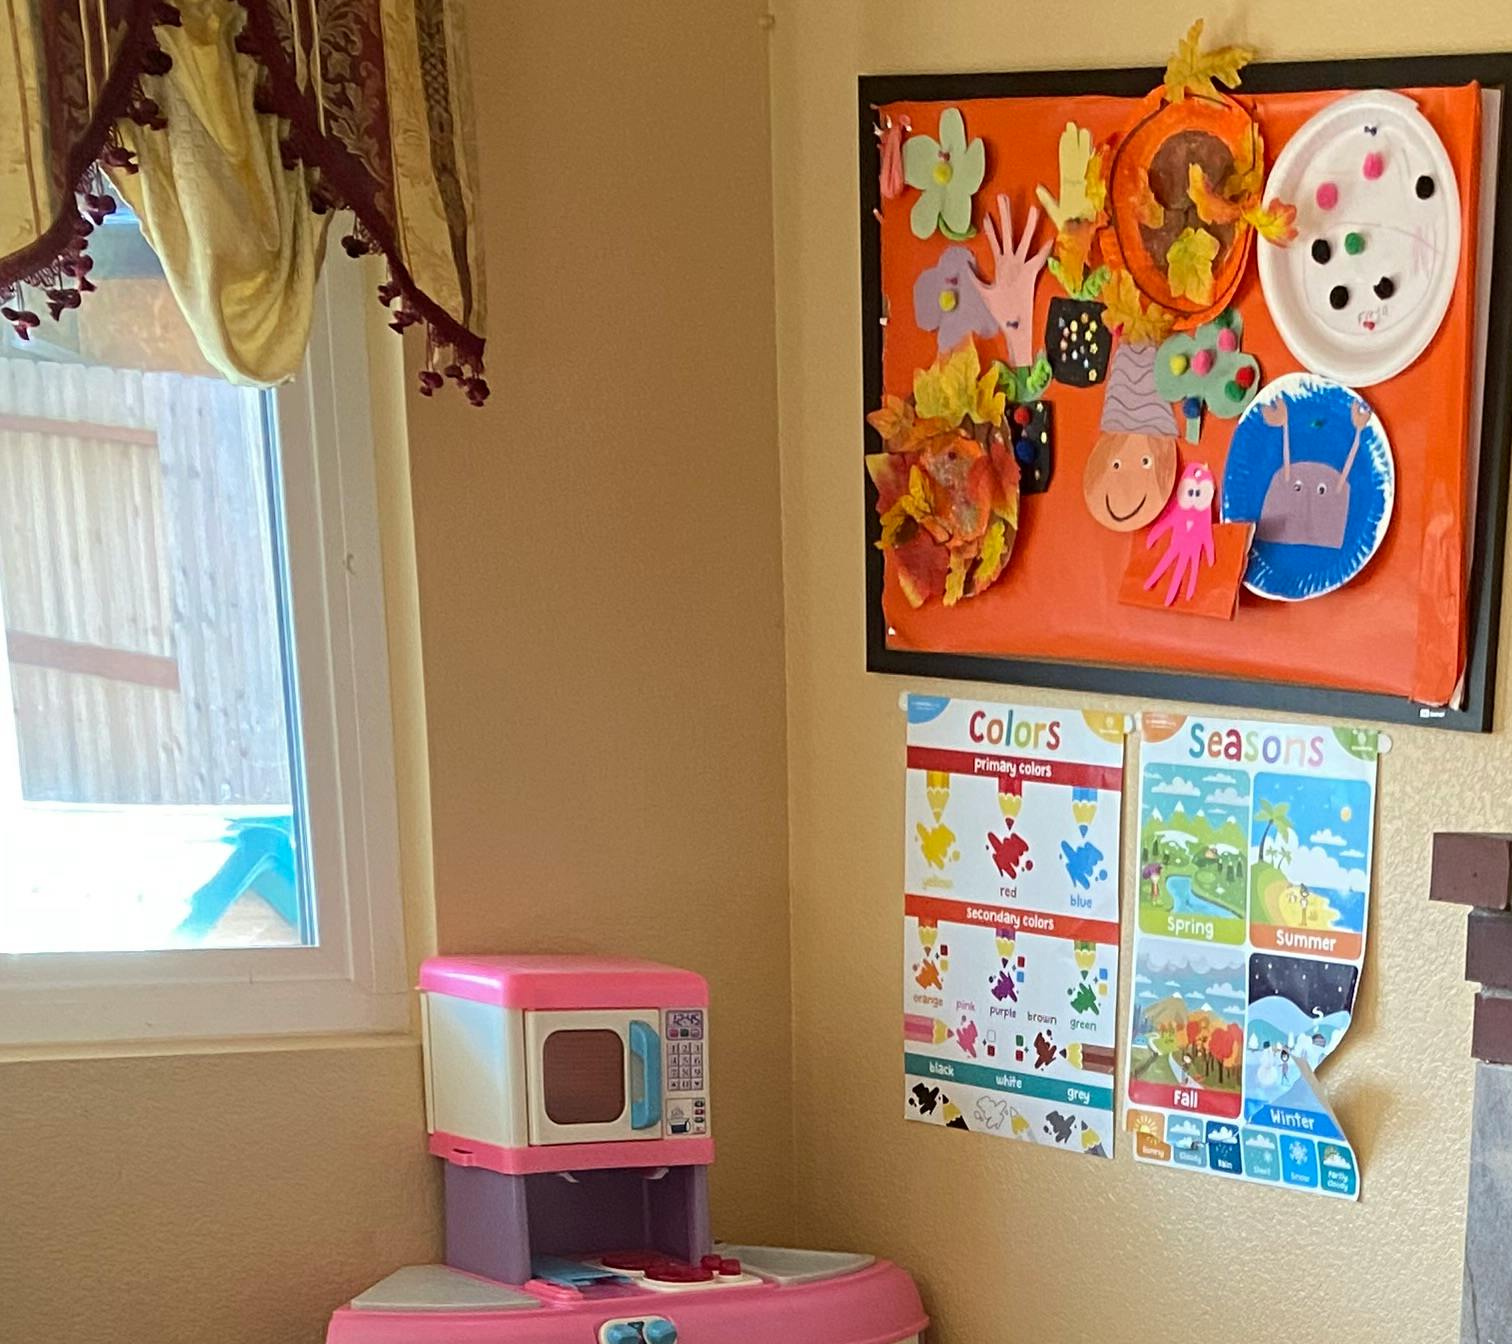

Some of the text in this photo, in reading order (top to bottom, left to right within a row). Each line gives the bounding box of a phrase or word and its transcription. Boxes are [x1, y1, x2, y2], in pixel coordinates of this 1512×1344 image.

[969, 709, 1061, 751] Colors
[1189, 722, 1325, 767] Seasons
[974, 758, 1052, 778] primary colors
[999, 886, 1018, 898] red
[1069, 895, 1093, 909] blue
[966, 906, 1055, 931] secondary colors
[1167, 916, 1214, 941] Spring
[1276, 929, 1337, 953] Summer
[913, 993, 944, 1008] orange
[956, 1000, 976, 1013] pink
[989, 1005, 1017, 1020] purple
[1027, 1011, 1057, 1026] brown
[1070, 1018, 1097, 1032] green
[929, 1062, 955, 1078] black
[995, 1074, 1023, 1090] white
[1067, 1087, 1090, 1104] grey
[1173, 1089, 1199, 1109] Fall
[1269, 1108, 1316, 1131] Winter
